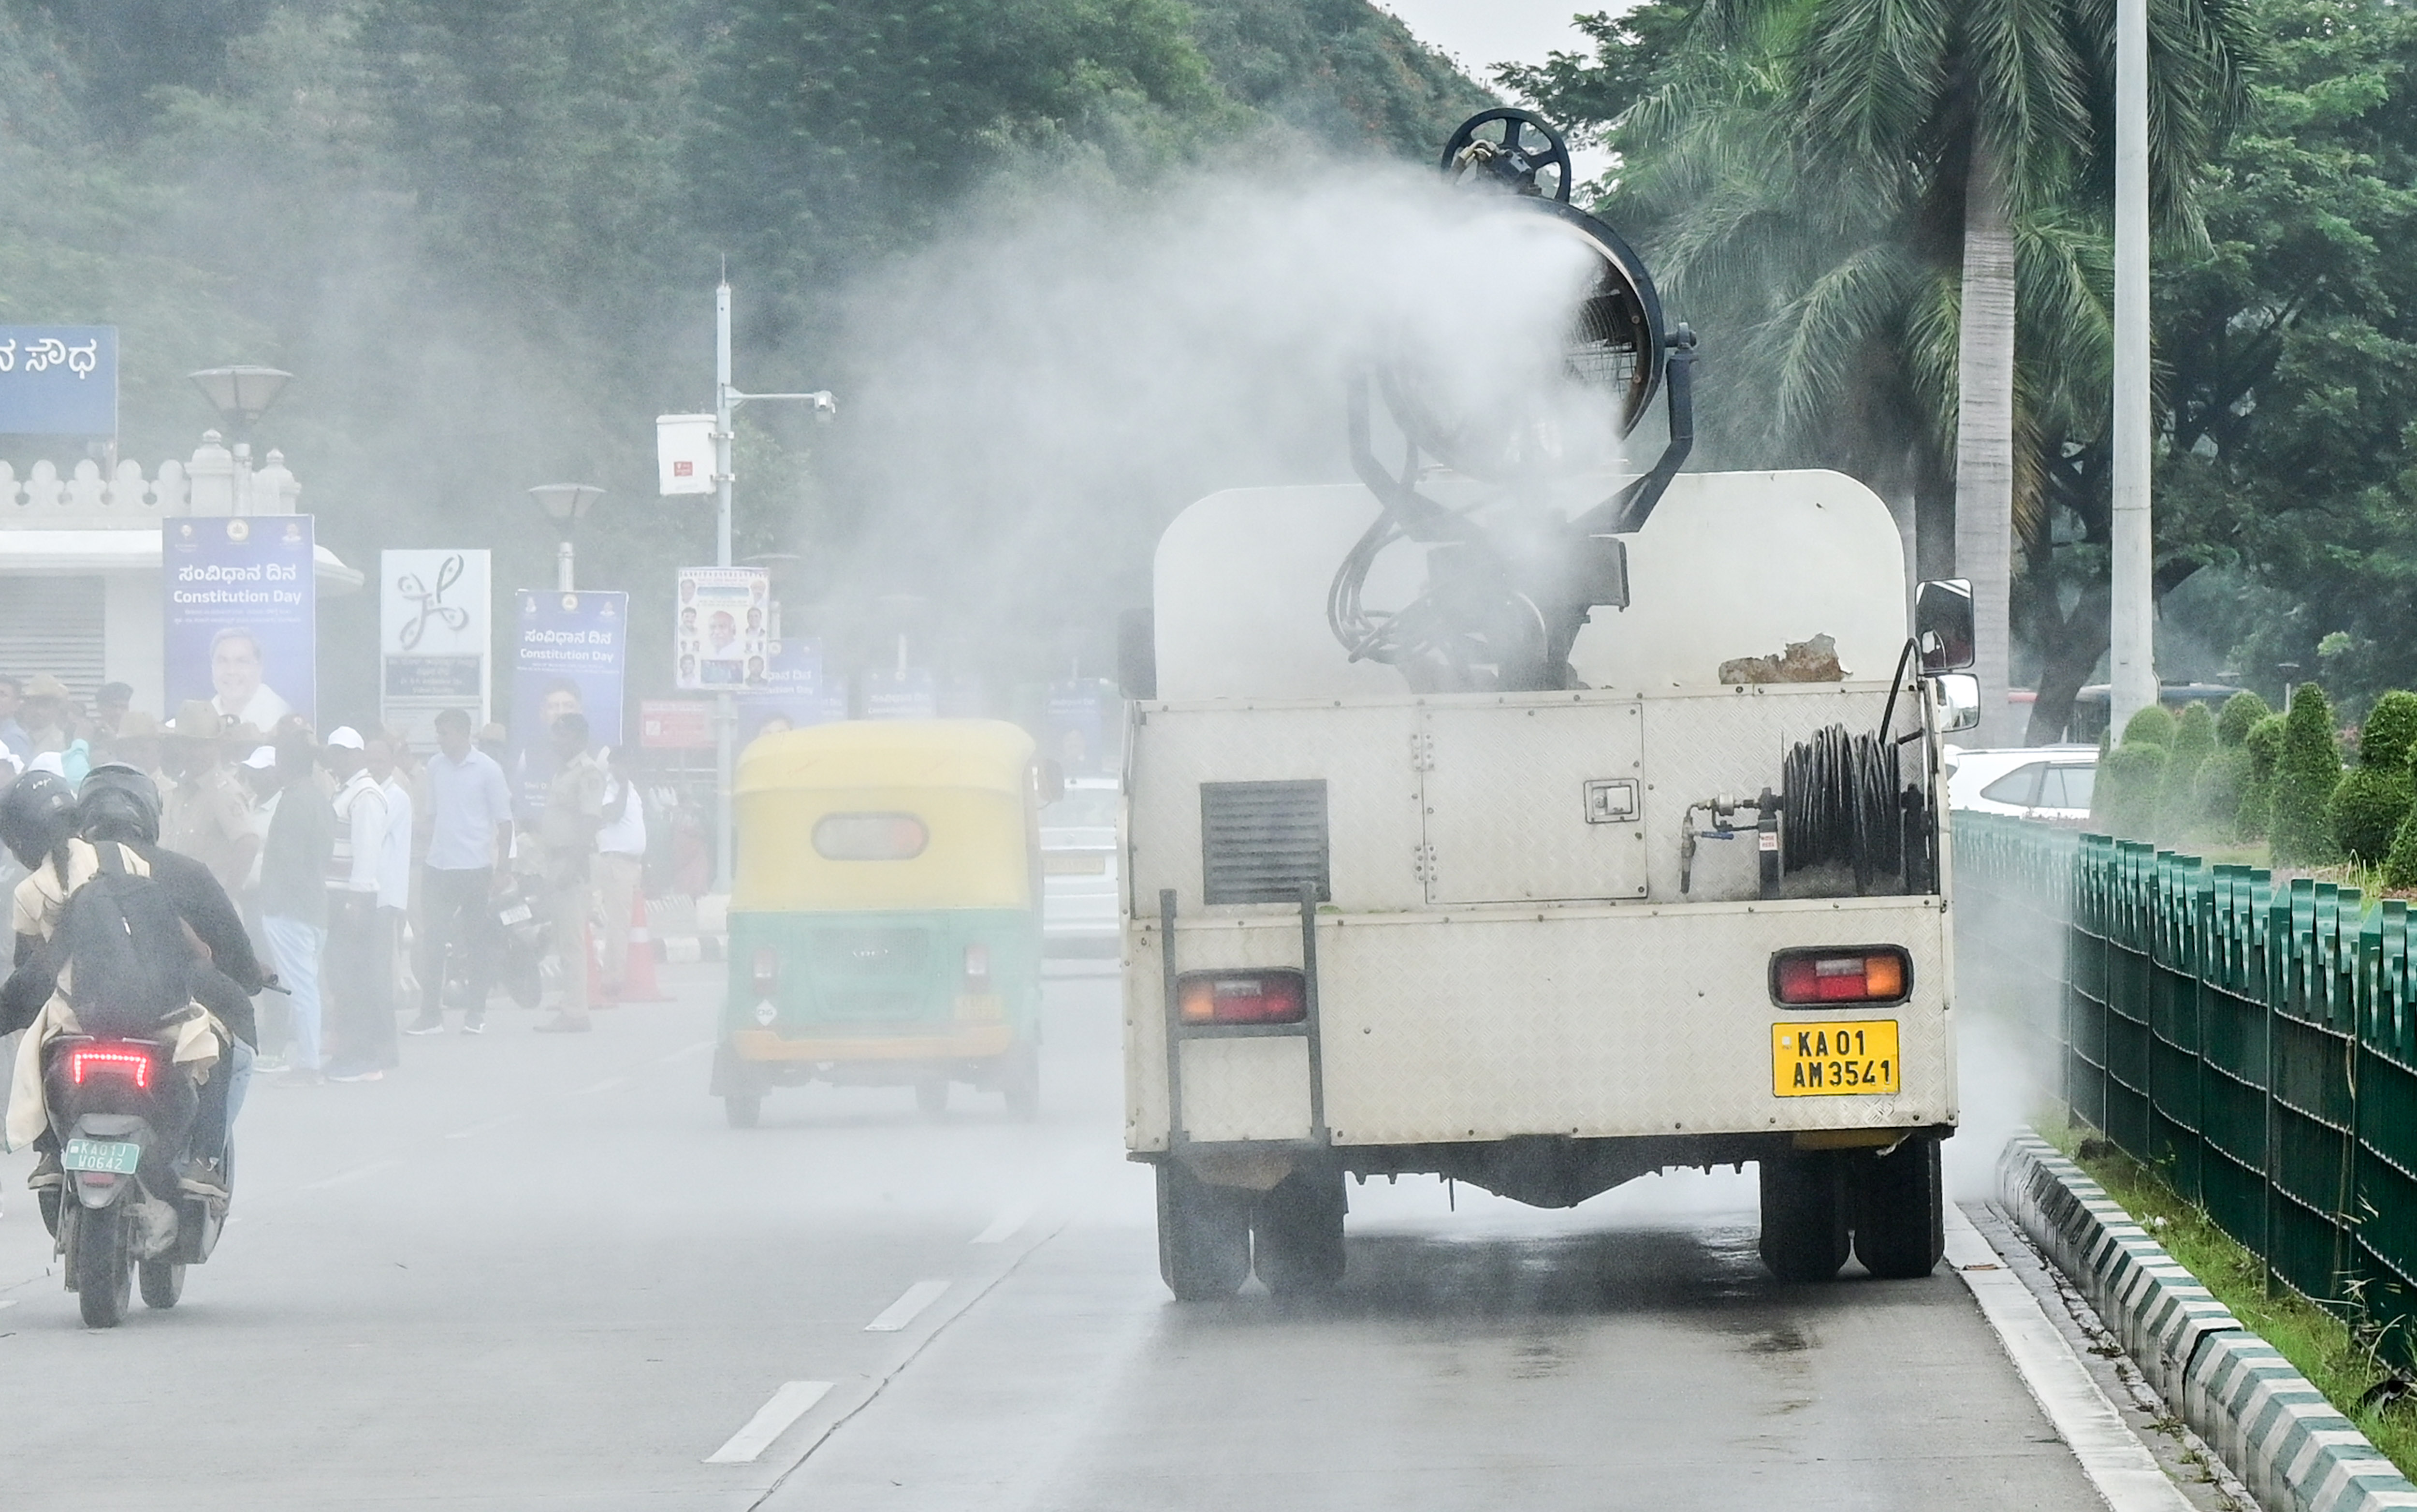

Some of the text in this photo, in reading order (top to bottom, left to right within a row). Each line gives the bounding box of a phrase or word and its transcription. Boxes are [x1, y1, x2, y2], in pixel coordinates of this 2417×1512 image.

[25, 338, 97, 380] ಸೌಧ
[178, 563, 296, 584] ಸಂವಿಧಾನ ದಿನ
[173, 590, 302, 605] Constitution Day
[524, 628, 612, 645] ಸಂವಿಧಾನ ದಿನ
[520, 648, 614, 663] Constitution Day
[80, 1141, 127, 1157] KA01J
[78, 1155, 123, 1170] W0642
